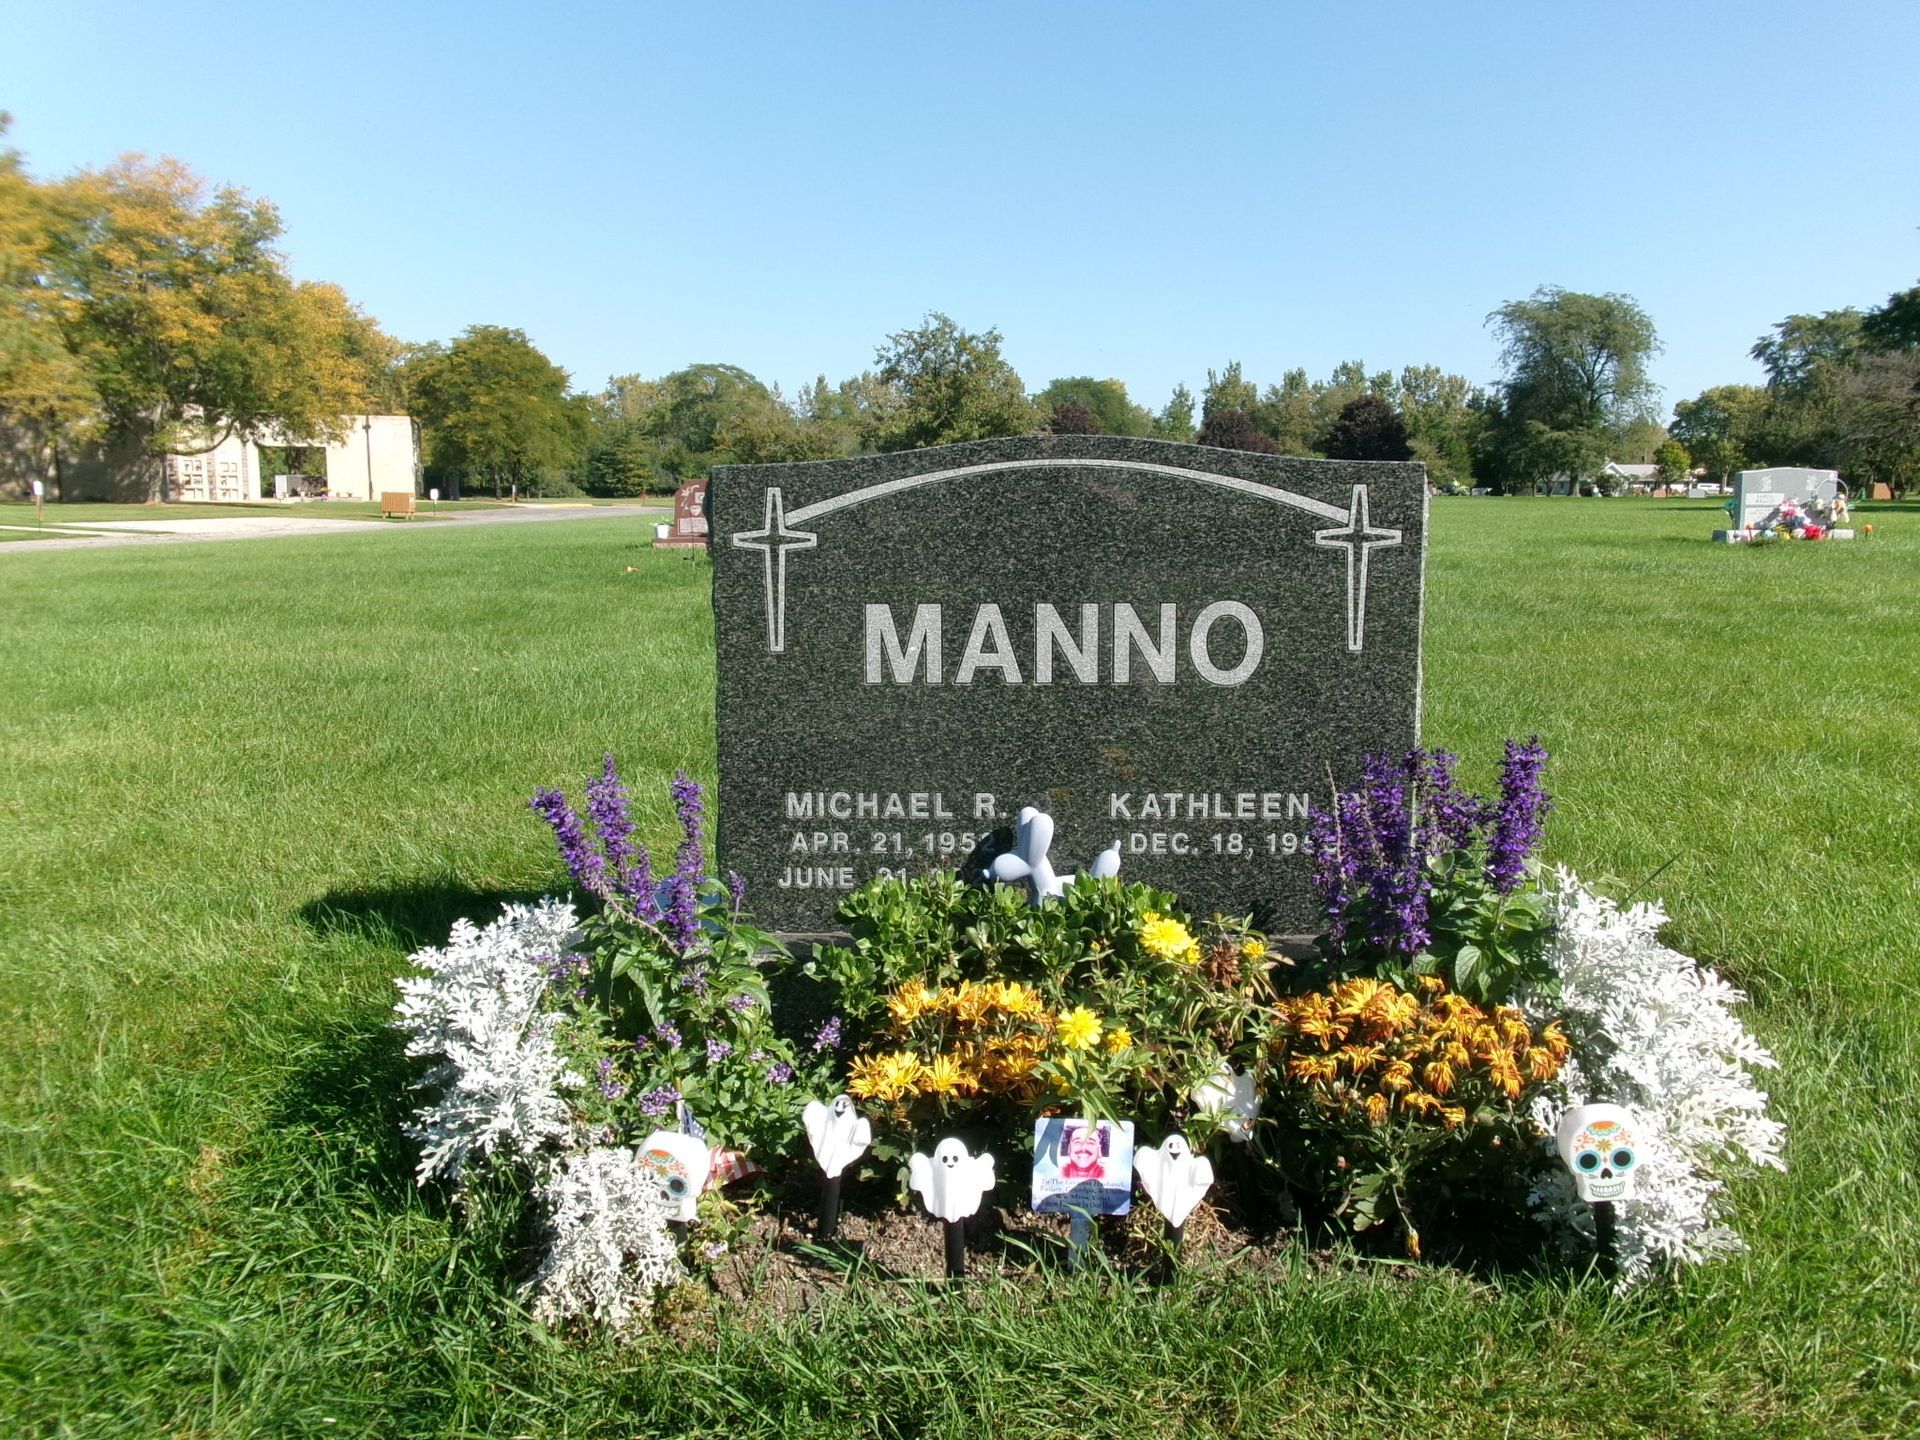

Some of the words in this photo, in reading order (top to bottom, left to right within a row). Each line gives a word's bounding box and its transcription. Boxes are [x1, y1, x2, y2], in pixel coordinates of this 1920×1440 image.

[864, 600, 1264, 686] MANNO
[786, 791, 953, 819] MICHAEL
[974, 792, 1007, 819] R.
[1109, 792, 1310, 819] KATHLEEN
[792, 832, 861, 852] APR.
[871, 832, 913, 858] 21,
[1130, 832, 1199, 854] DEC.
[1212, 832, 1254, 859] 18,
[777, 867, 854, 888] JUNE
